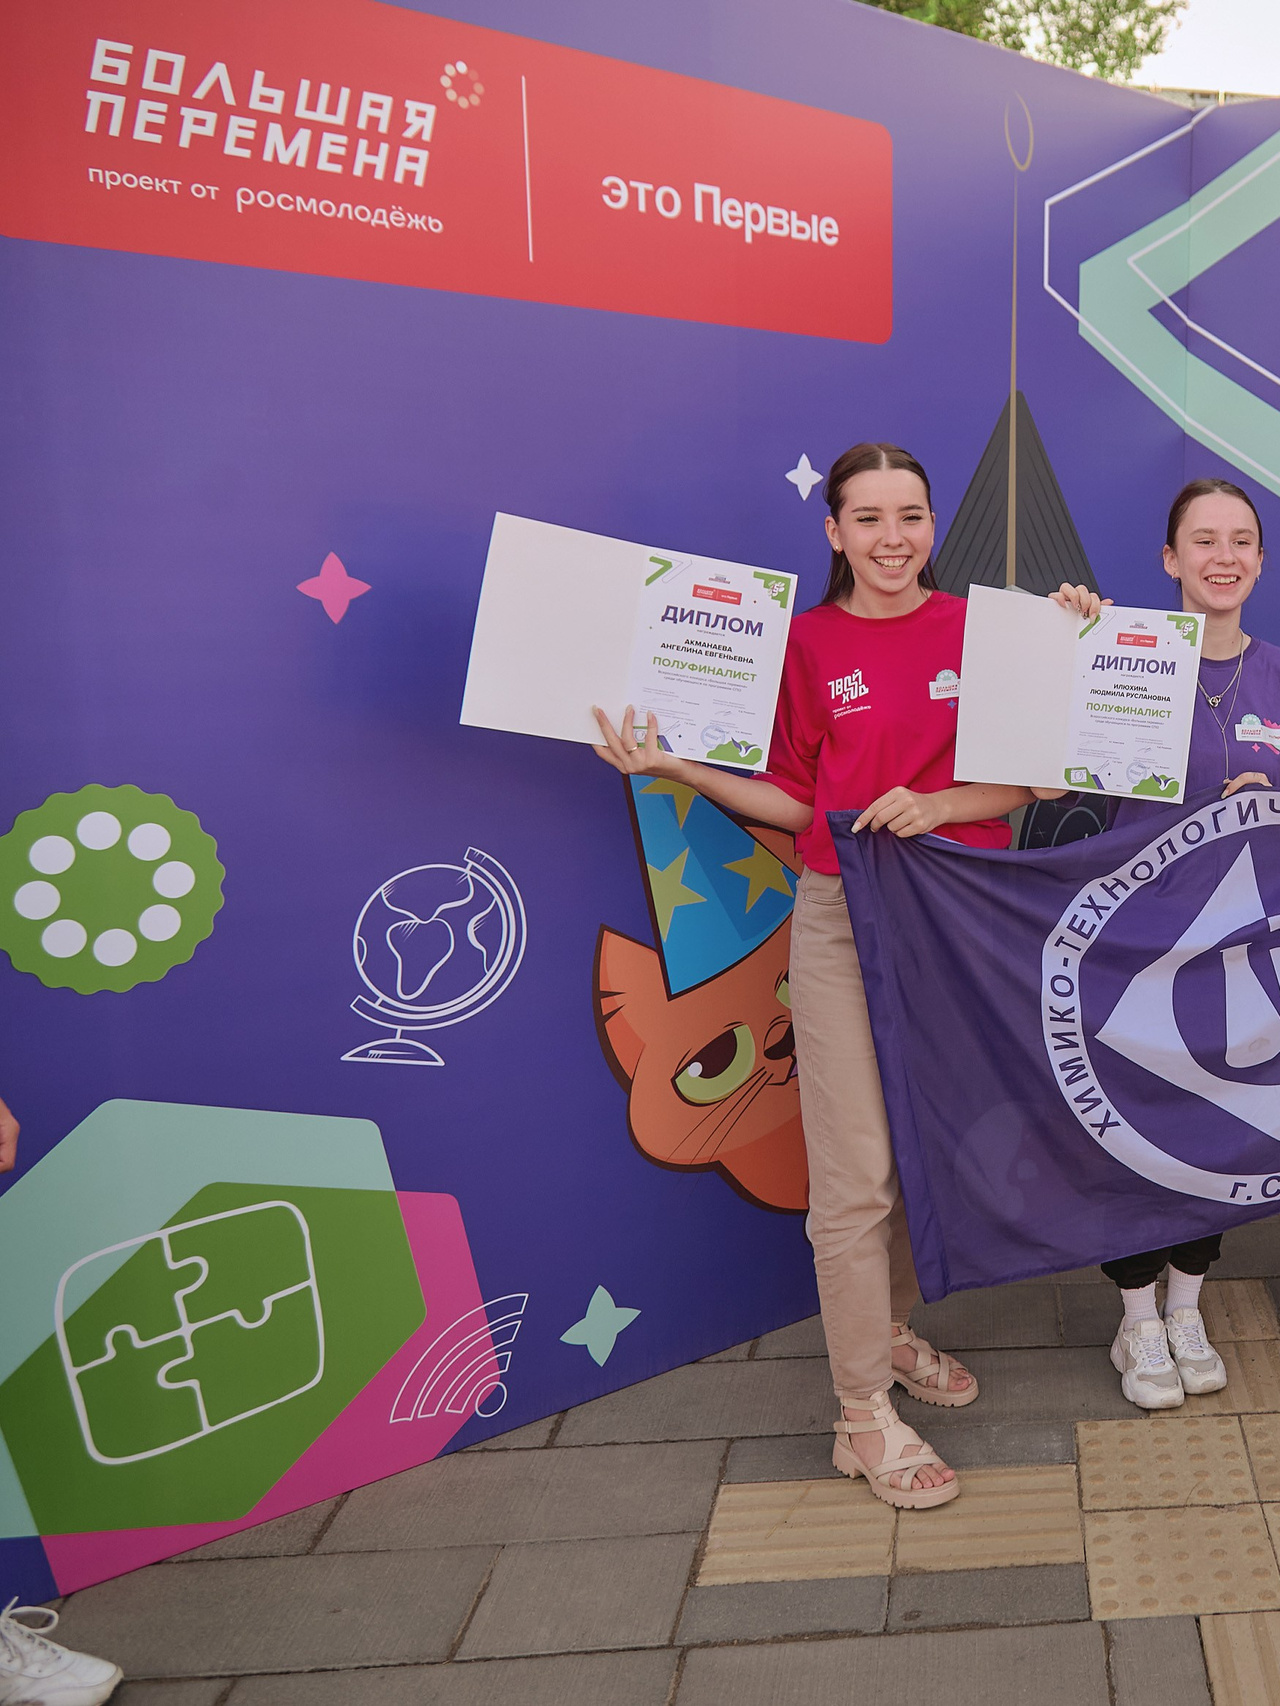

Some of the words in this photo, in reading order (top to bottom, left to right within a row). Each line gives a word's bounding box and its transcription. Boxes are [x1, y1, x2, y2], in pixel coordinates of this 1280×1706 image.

[89, 38, 437, 142] БОЛЬШАЯ
[84, 89, 430, 187] ПЕРЕМЕНА
[87, 167, 182, 195] проект
[190, 183, 220, 200] от
[235, 186, 444, 233] росмолодёжь
[601, 175, 682, 219] это
[693, 182, 840, 246] Первые
[661, 605, 764, 637] ДИПЛОМ
[660, 642, 703, 656] АНГЕЛИНА
[704, 650, 755, 665] ЕВГЕНЬЕВНА
[684, 638, 733, 653] АКМАНАЕВА
[652, 656, 757, 682] ПОЛУФИНАЛИСТ
[1091, 654, 1177, 676] ДИПЛОМ
[1089, 688, 1125, 698] ЛЮДМИЛА
[1126, 692, 1171, 702] РУСЛАНОВНА
[1113, 683, 1148, 692] ИЛЮХИНА
[1086, 702, 1173, 719] ПОЛУФИНАЛИСТ
